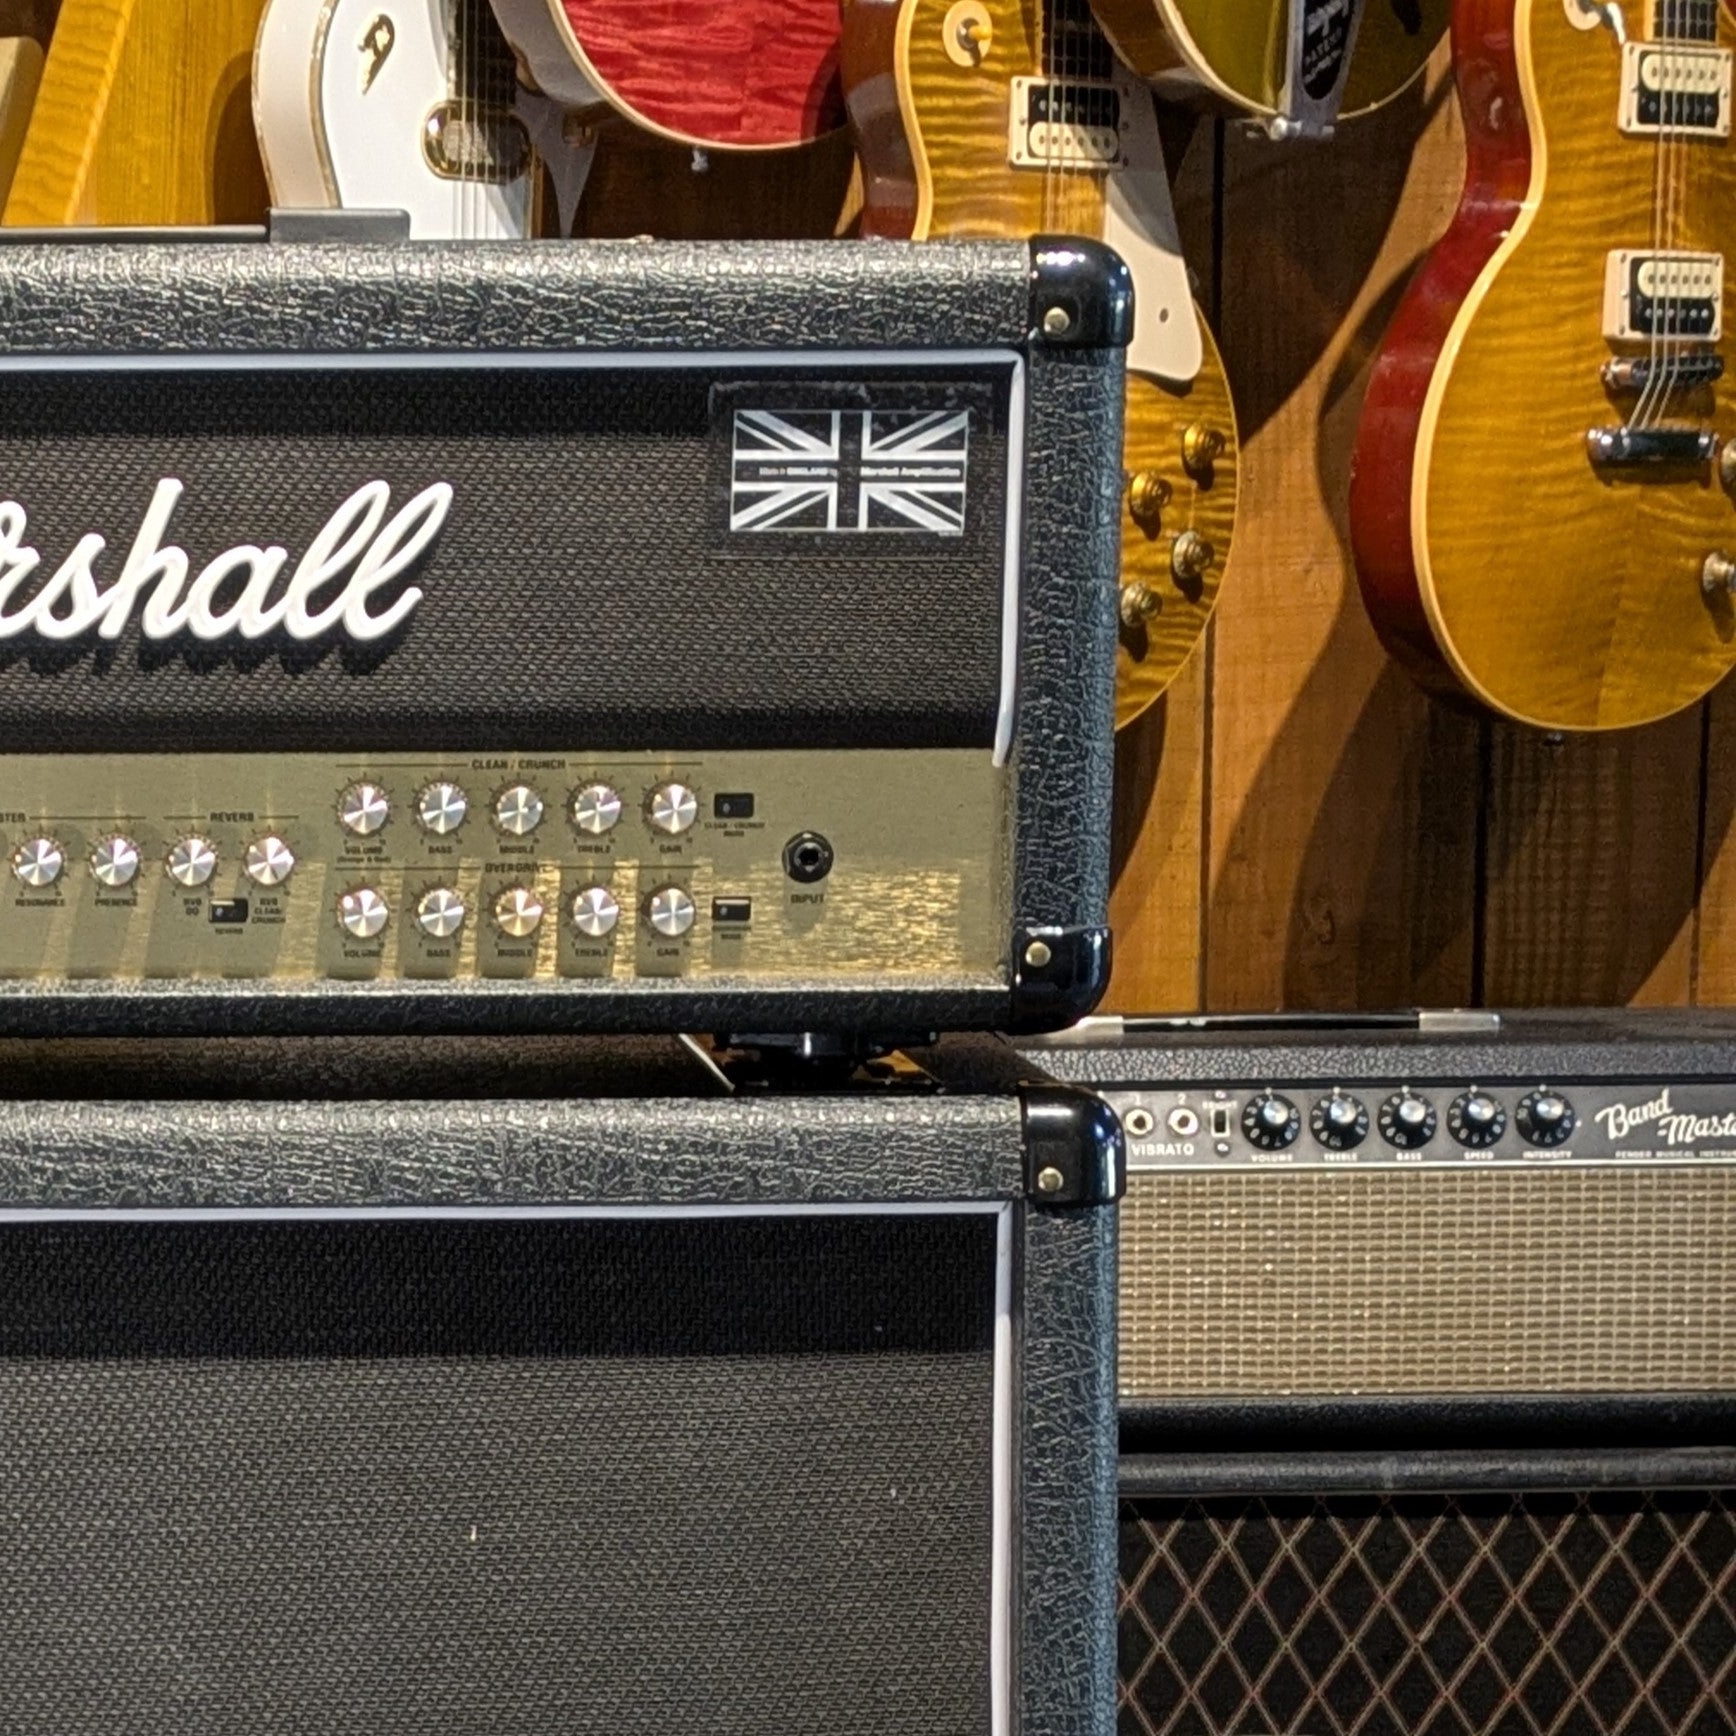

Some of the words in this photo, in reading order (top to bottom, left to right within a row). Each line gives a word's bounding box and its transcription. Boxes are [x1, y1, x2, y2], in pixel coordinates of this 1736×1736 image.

[471, 759, 509, 769] CLEAN
[518, 758, 566, 769] CRUNCH
[210, 812, 254, 822] REVERB
[428, 845, 453, 854] BASS
[659, 845, 682, 854] GAIN
[484, 862, 550, 874] OVERDRIV
[790, 893, 825, 905] INPUT
[427, 949, 451, 958] BASS
[1594, 1086, 1675, 1141] Band
[1131, 1142, 1196, 1157] VIBRATO
[1250, 1153, 1293, 1162] VOLUME
[1323, 1152, 1358, 1162] TREBLE
[1396, 1152, 1422, 1161] BASS
[1464, 1150, 1495, 1160] SPEED
